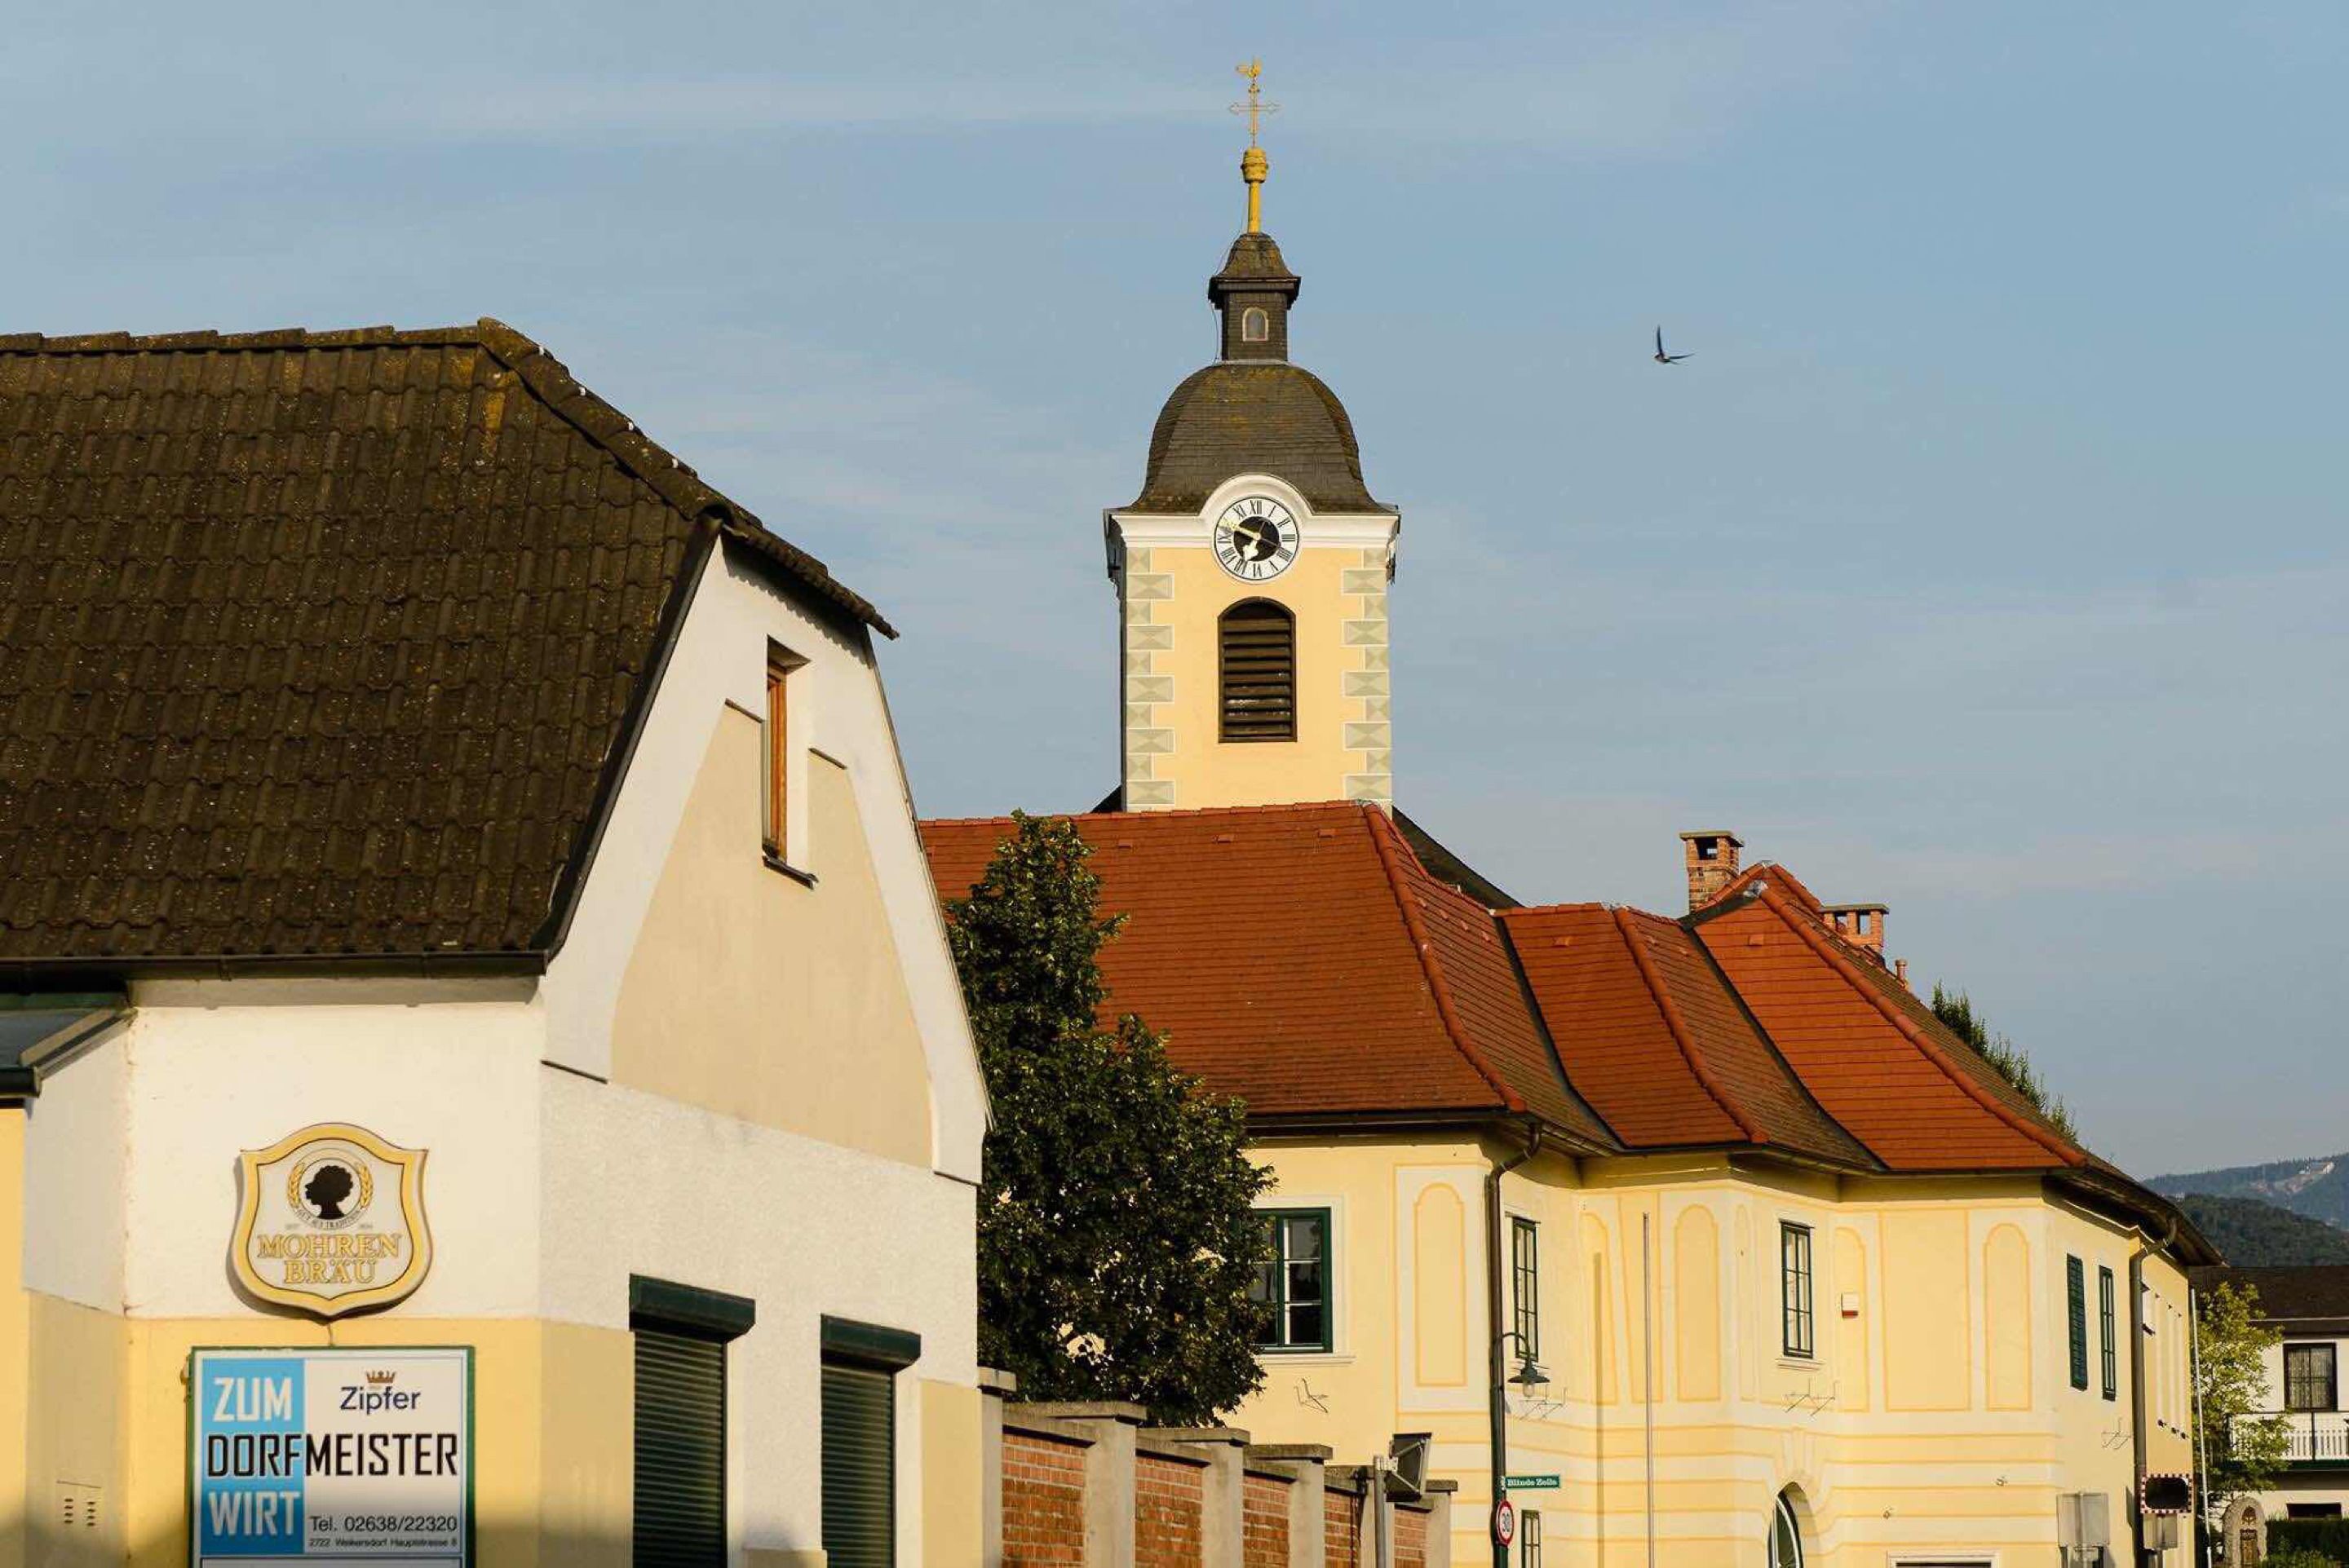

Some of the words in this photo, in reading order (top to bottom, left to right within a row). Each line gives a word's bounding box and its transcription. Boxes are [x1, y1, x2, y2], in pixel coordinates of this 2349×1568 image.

[1232, 505, 1247, 520] XI
[1250, 500, 1263, 515] XII
[1268, 505, 1276, 518] I
[1276, 517, 1292, 528] II
[1281, 534, 1295, 542] III
[257, 1233, 402, 1259] MOHREN
[214, 1376, 293, 1421] ZUM
[340, 1385, 422, 1416] Zipfer
[208, 1491, 301, 1537] WIRT
[310, 1515, 338, 1531] Tel.
[343, 1515, 458, 1533] 02638/22320
